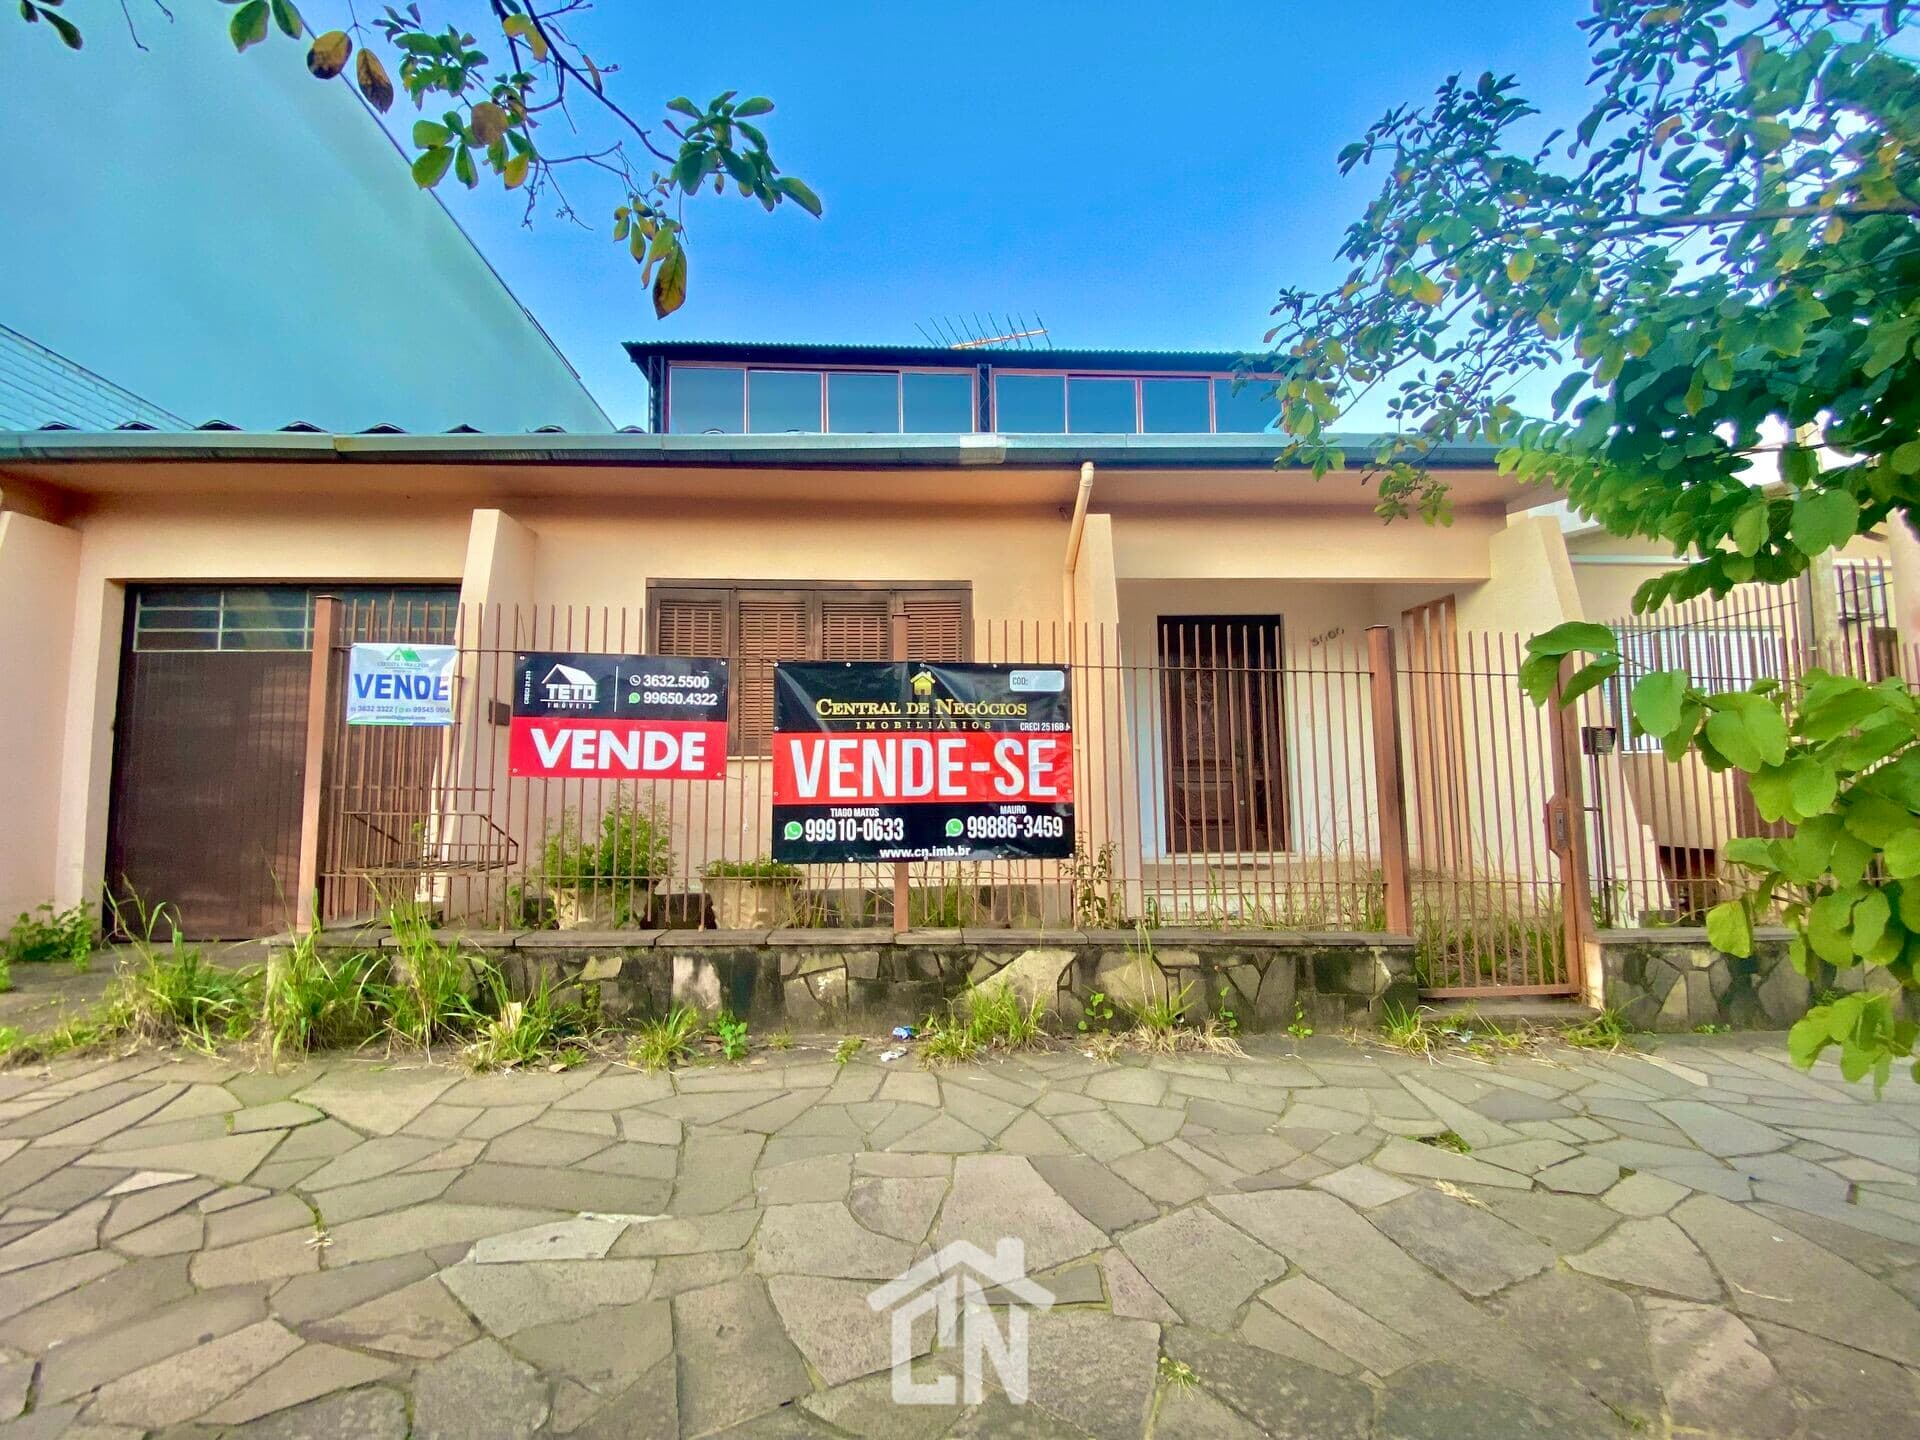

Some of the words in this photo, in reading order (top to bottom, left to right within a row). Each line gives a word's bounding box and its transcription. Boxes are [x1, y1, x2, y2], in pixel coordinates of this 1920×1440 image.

[353, 673, 449, 701] VENDE
[643, 674, 709, 688] 3632.5500
[546, 684, 596, 701] TETO
[643, 692, 718, 706] 99650.4322
[815, 698, 901, 717] CENTRAL
[907, 702, 929, 716] DE
[855, 719, 992, 730] IMOBILIÁRIOS
[1019, 722, 1040, 731] CRECI
[530, 728, 706, 771] VENDE
[790, 738, 1057, 798] VENDE-SE
[830, 808, 852, 818] TIAGO
[854, 808, 880, 817] MATOS
[1000, 805, 1027, 815] MAURO
[804, 818, 904, 842] 99910-0633
[966, 815, 1063, 839] 99886-3459
[880, 845, 971, 859] www.cn.imb.br
